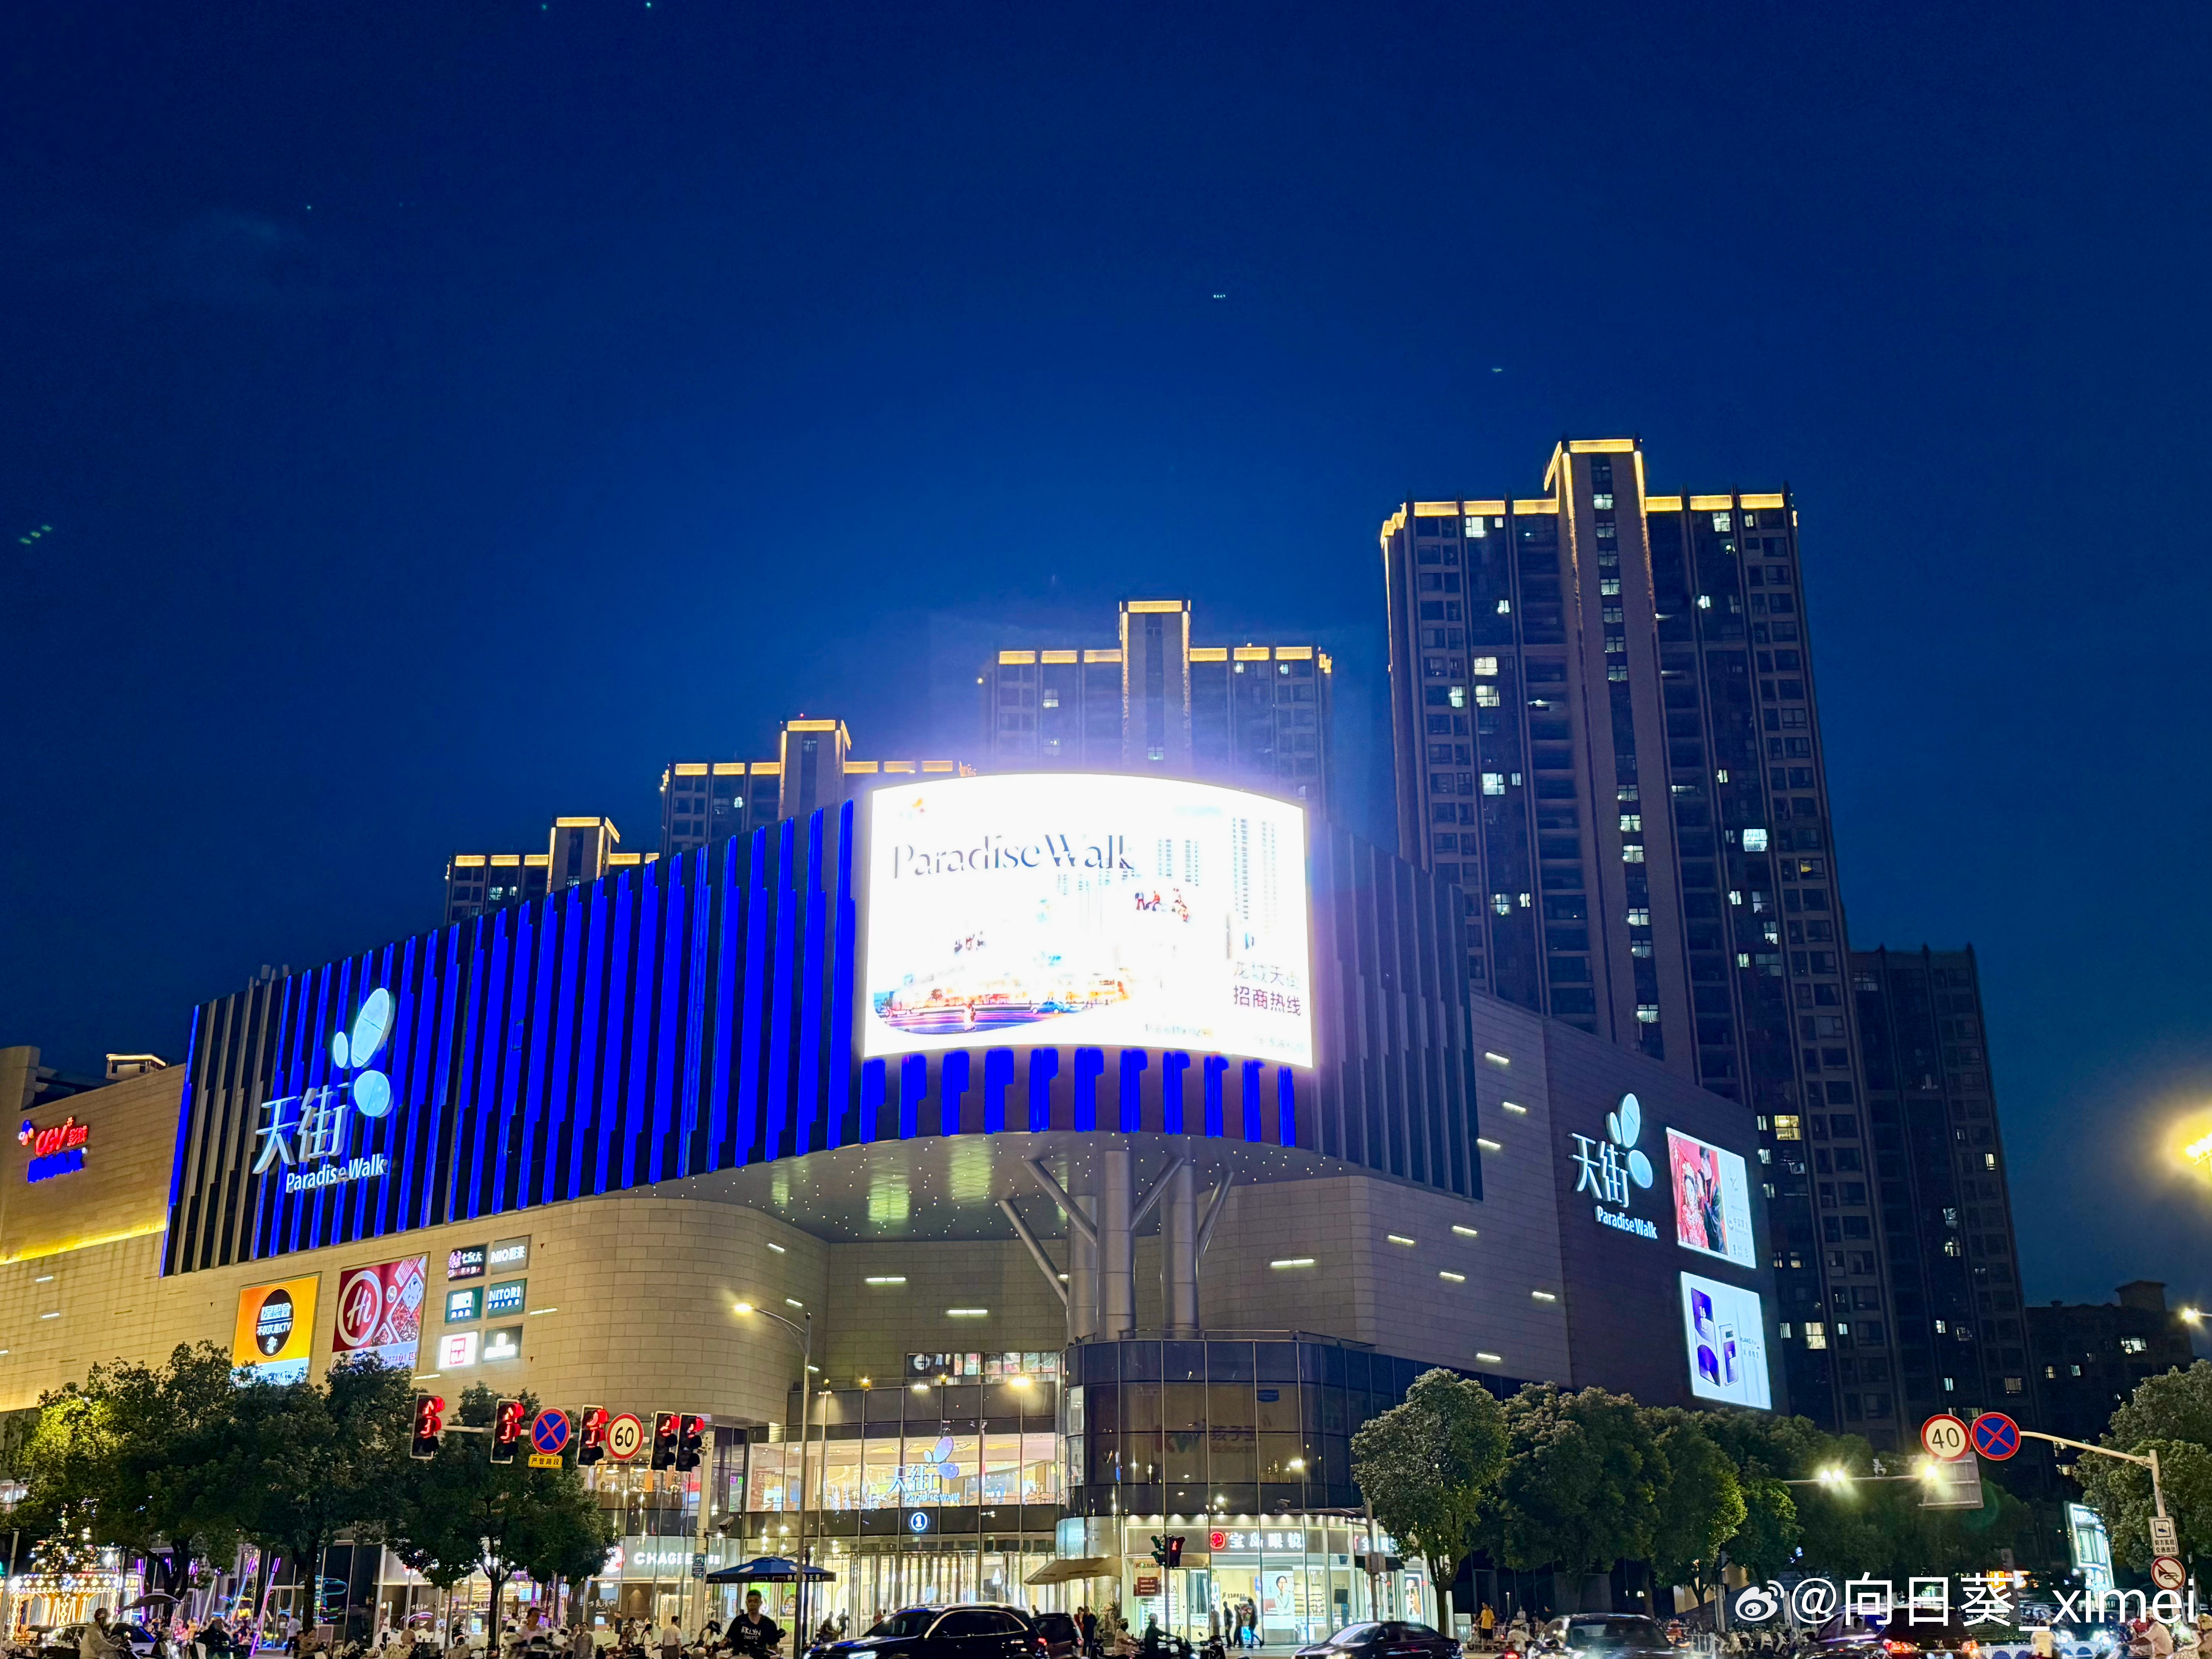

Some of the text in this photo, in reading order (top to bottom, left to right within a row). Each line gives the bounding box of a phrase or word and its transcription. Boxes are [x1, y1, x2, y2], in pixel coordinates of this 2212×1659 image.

[1233, 985, 1301, 1016] 招商热线
[252, 1082, 350, 1175] 天街
[1568, 1132, 1629, 1208] 天街
[488, 1286, 521, 1302] NITORI
[615, 1426, 634, 1448] 60
[1932, 1427, 1960, 1449] 40
[531, 1457, 560, 1465] 严管路段
[886, 1463, 939, 1493] 天街
